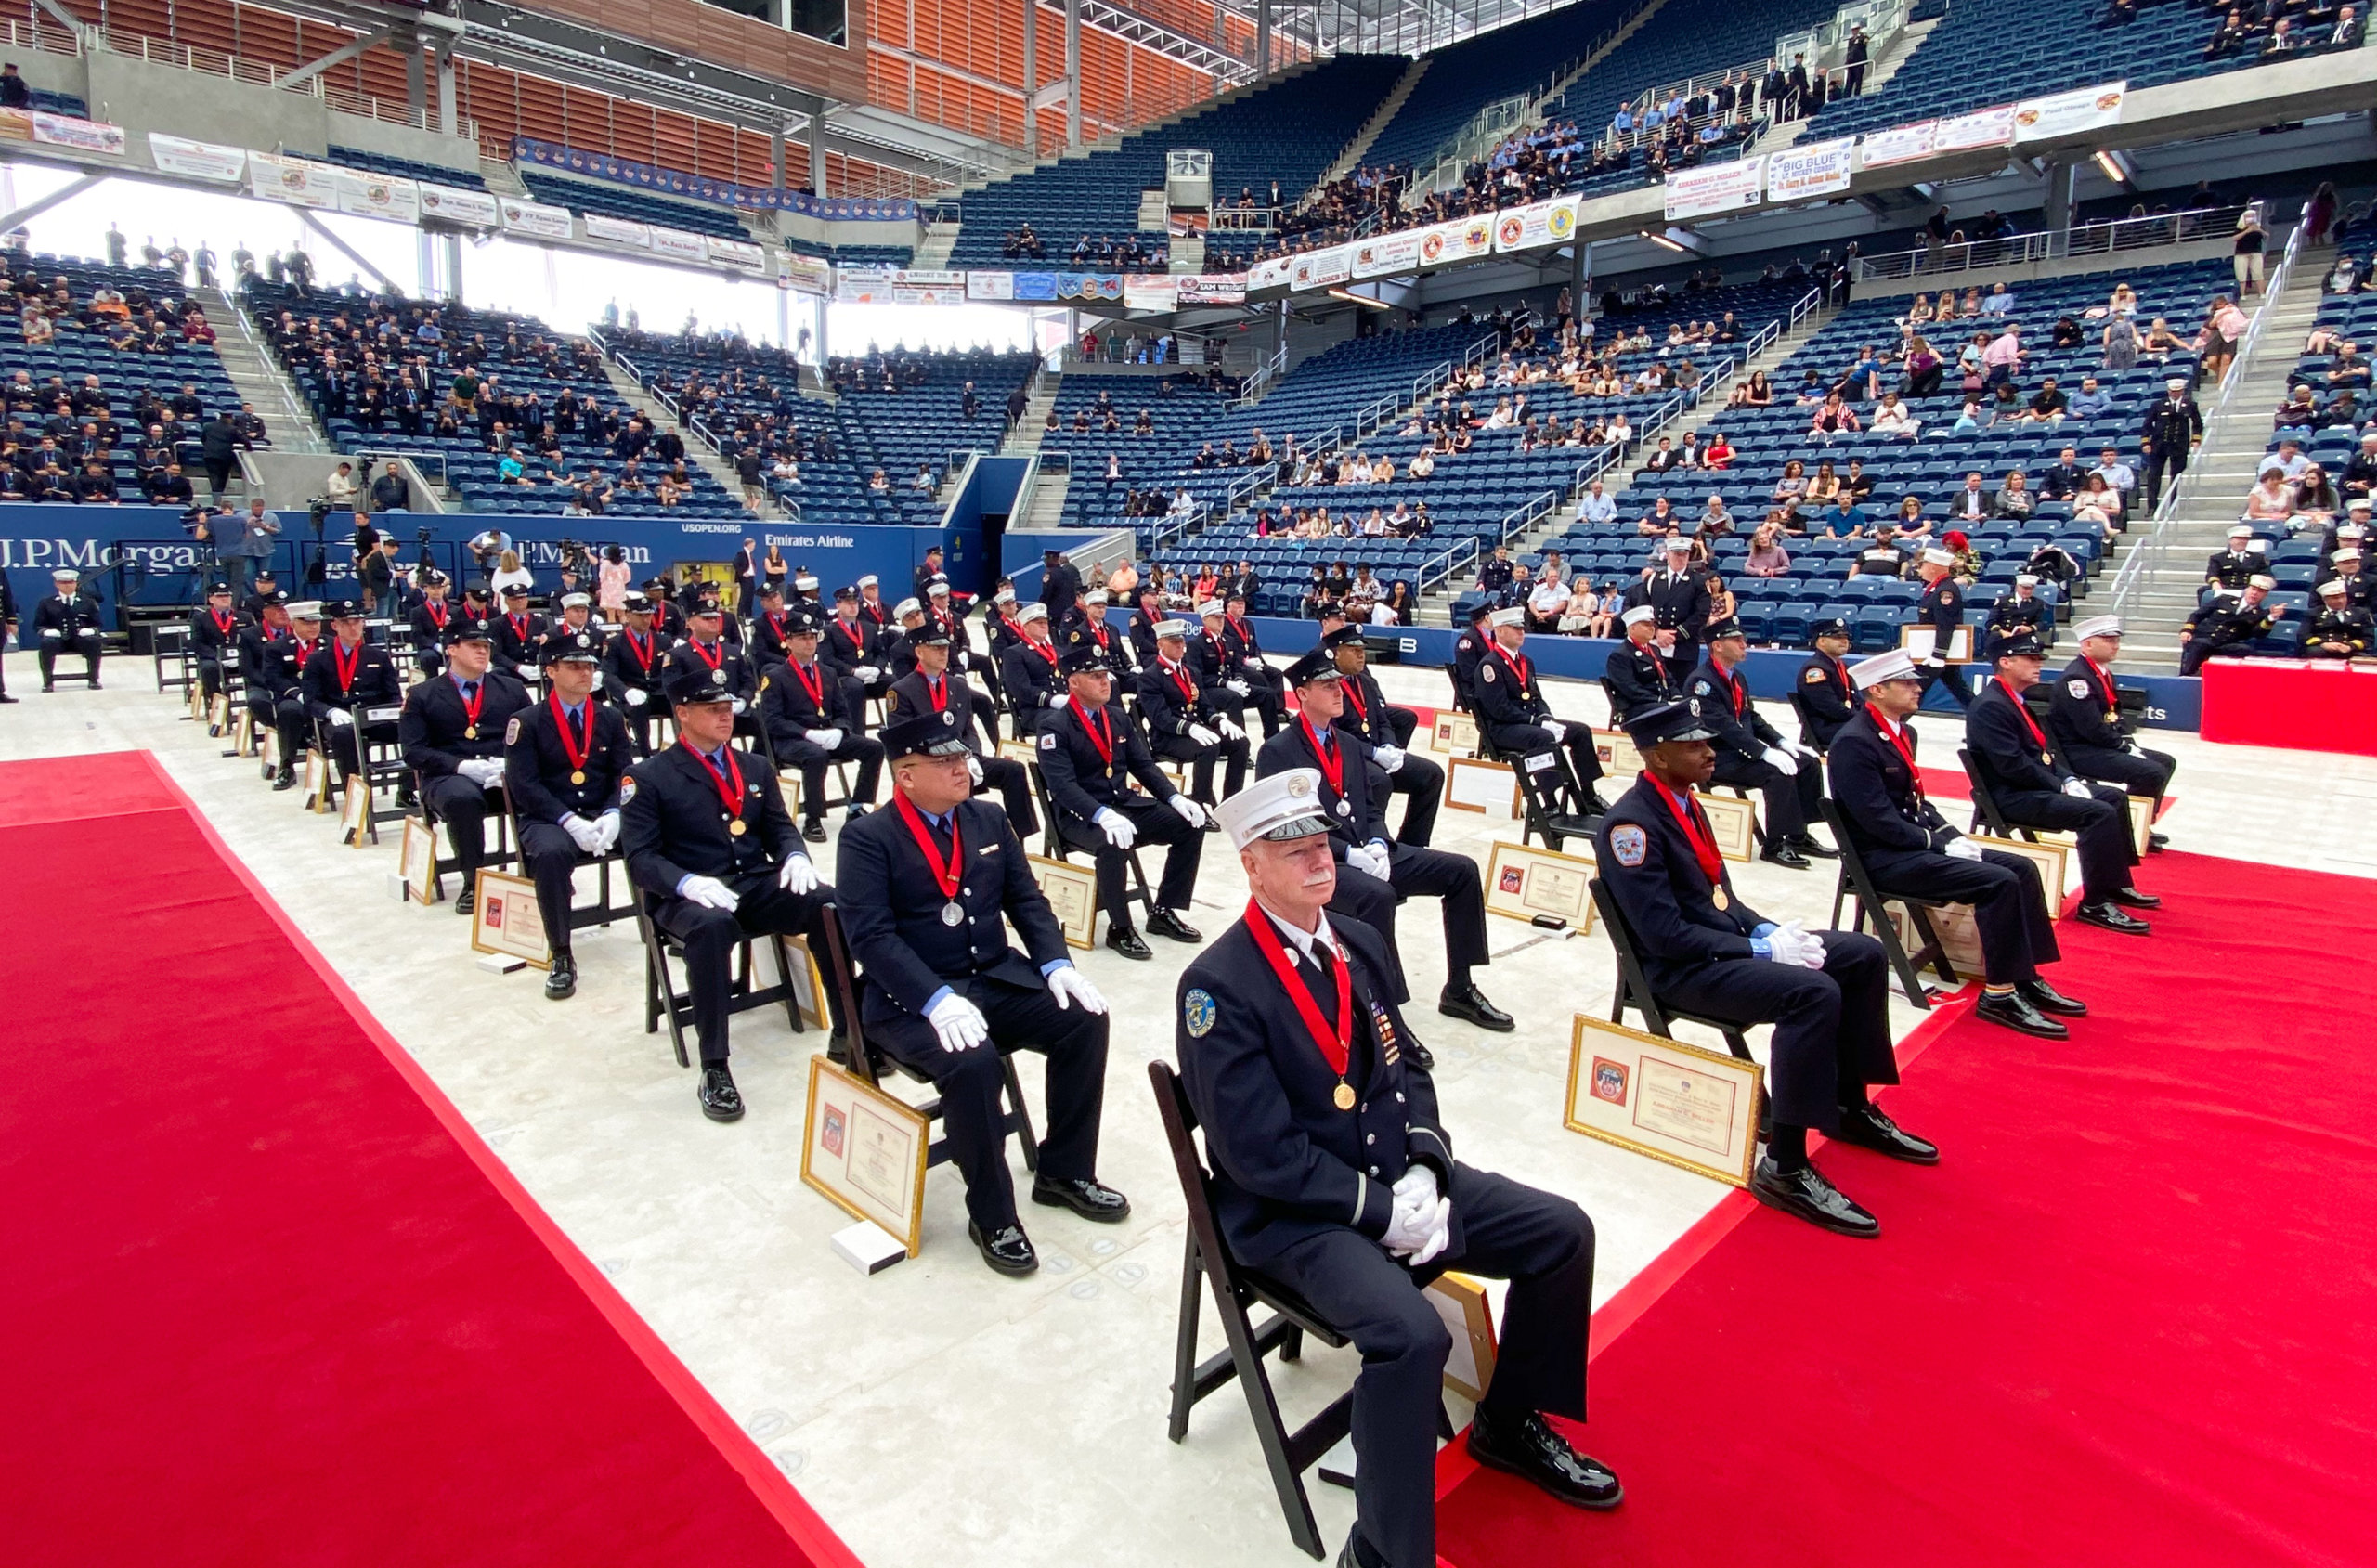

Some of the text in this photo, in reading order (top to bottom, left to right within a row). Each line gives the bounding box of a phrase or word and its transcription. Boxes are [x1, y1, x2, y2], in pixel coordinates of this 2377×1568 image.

[681, 523, 742, 534] USOPEN.ORG
[765, 533, 854, 548] Emirates Airline
